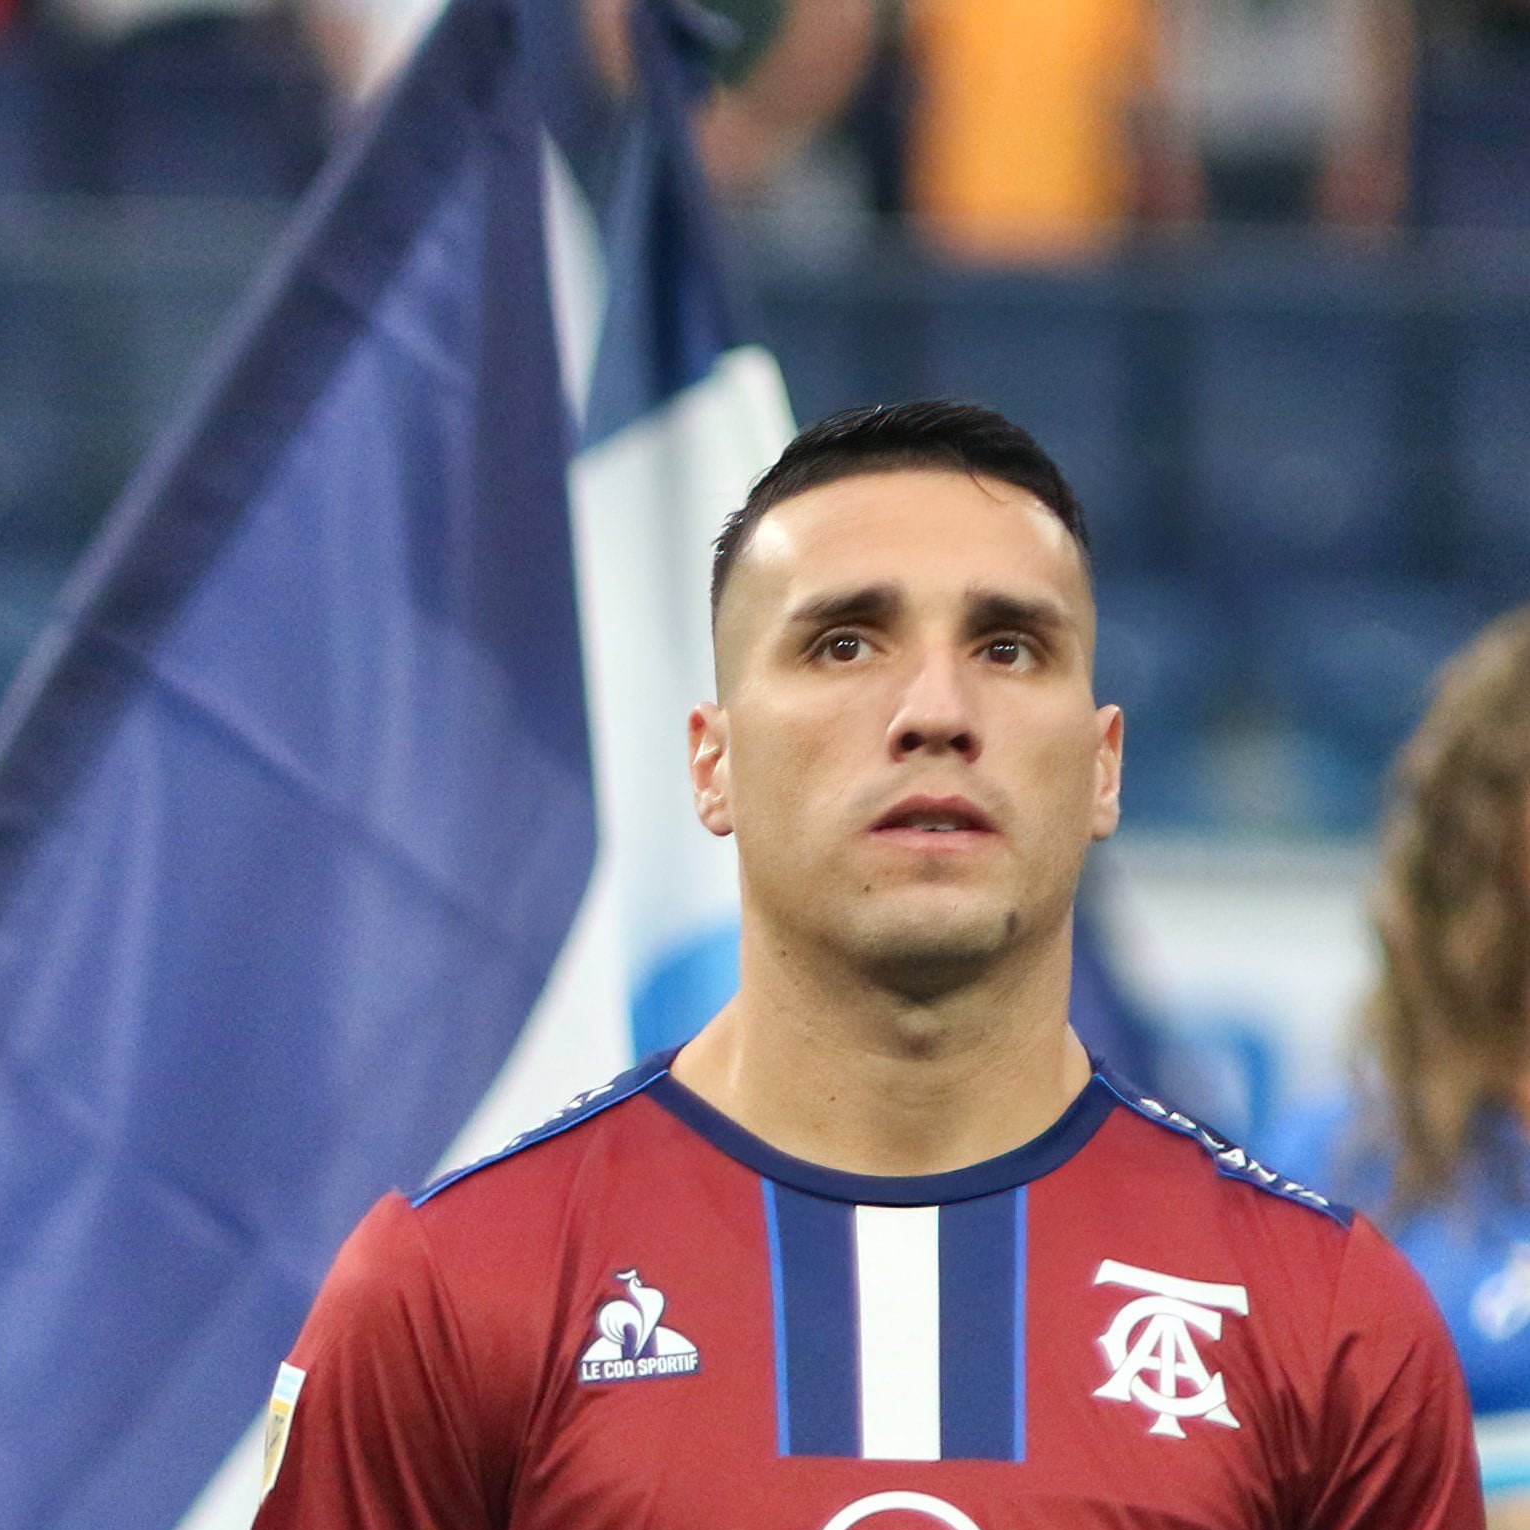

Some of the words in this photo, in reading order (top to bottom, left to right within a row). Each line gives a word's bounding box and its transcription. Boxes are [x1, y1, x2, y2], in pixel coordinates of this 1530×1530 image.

[581, 1362, 601, 1381] LE
[603, 1358, 635, 1380] COQ
[637, 1352, 700, 1376] SPORTIF
